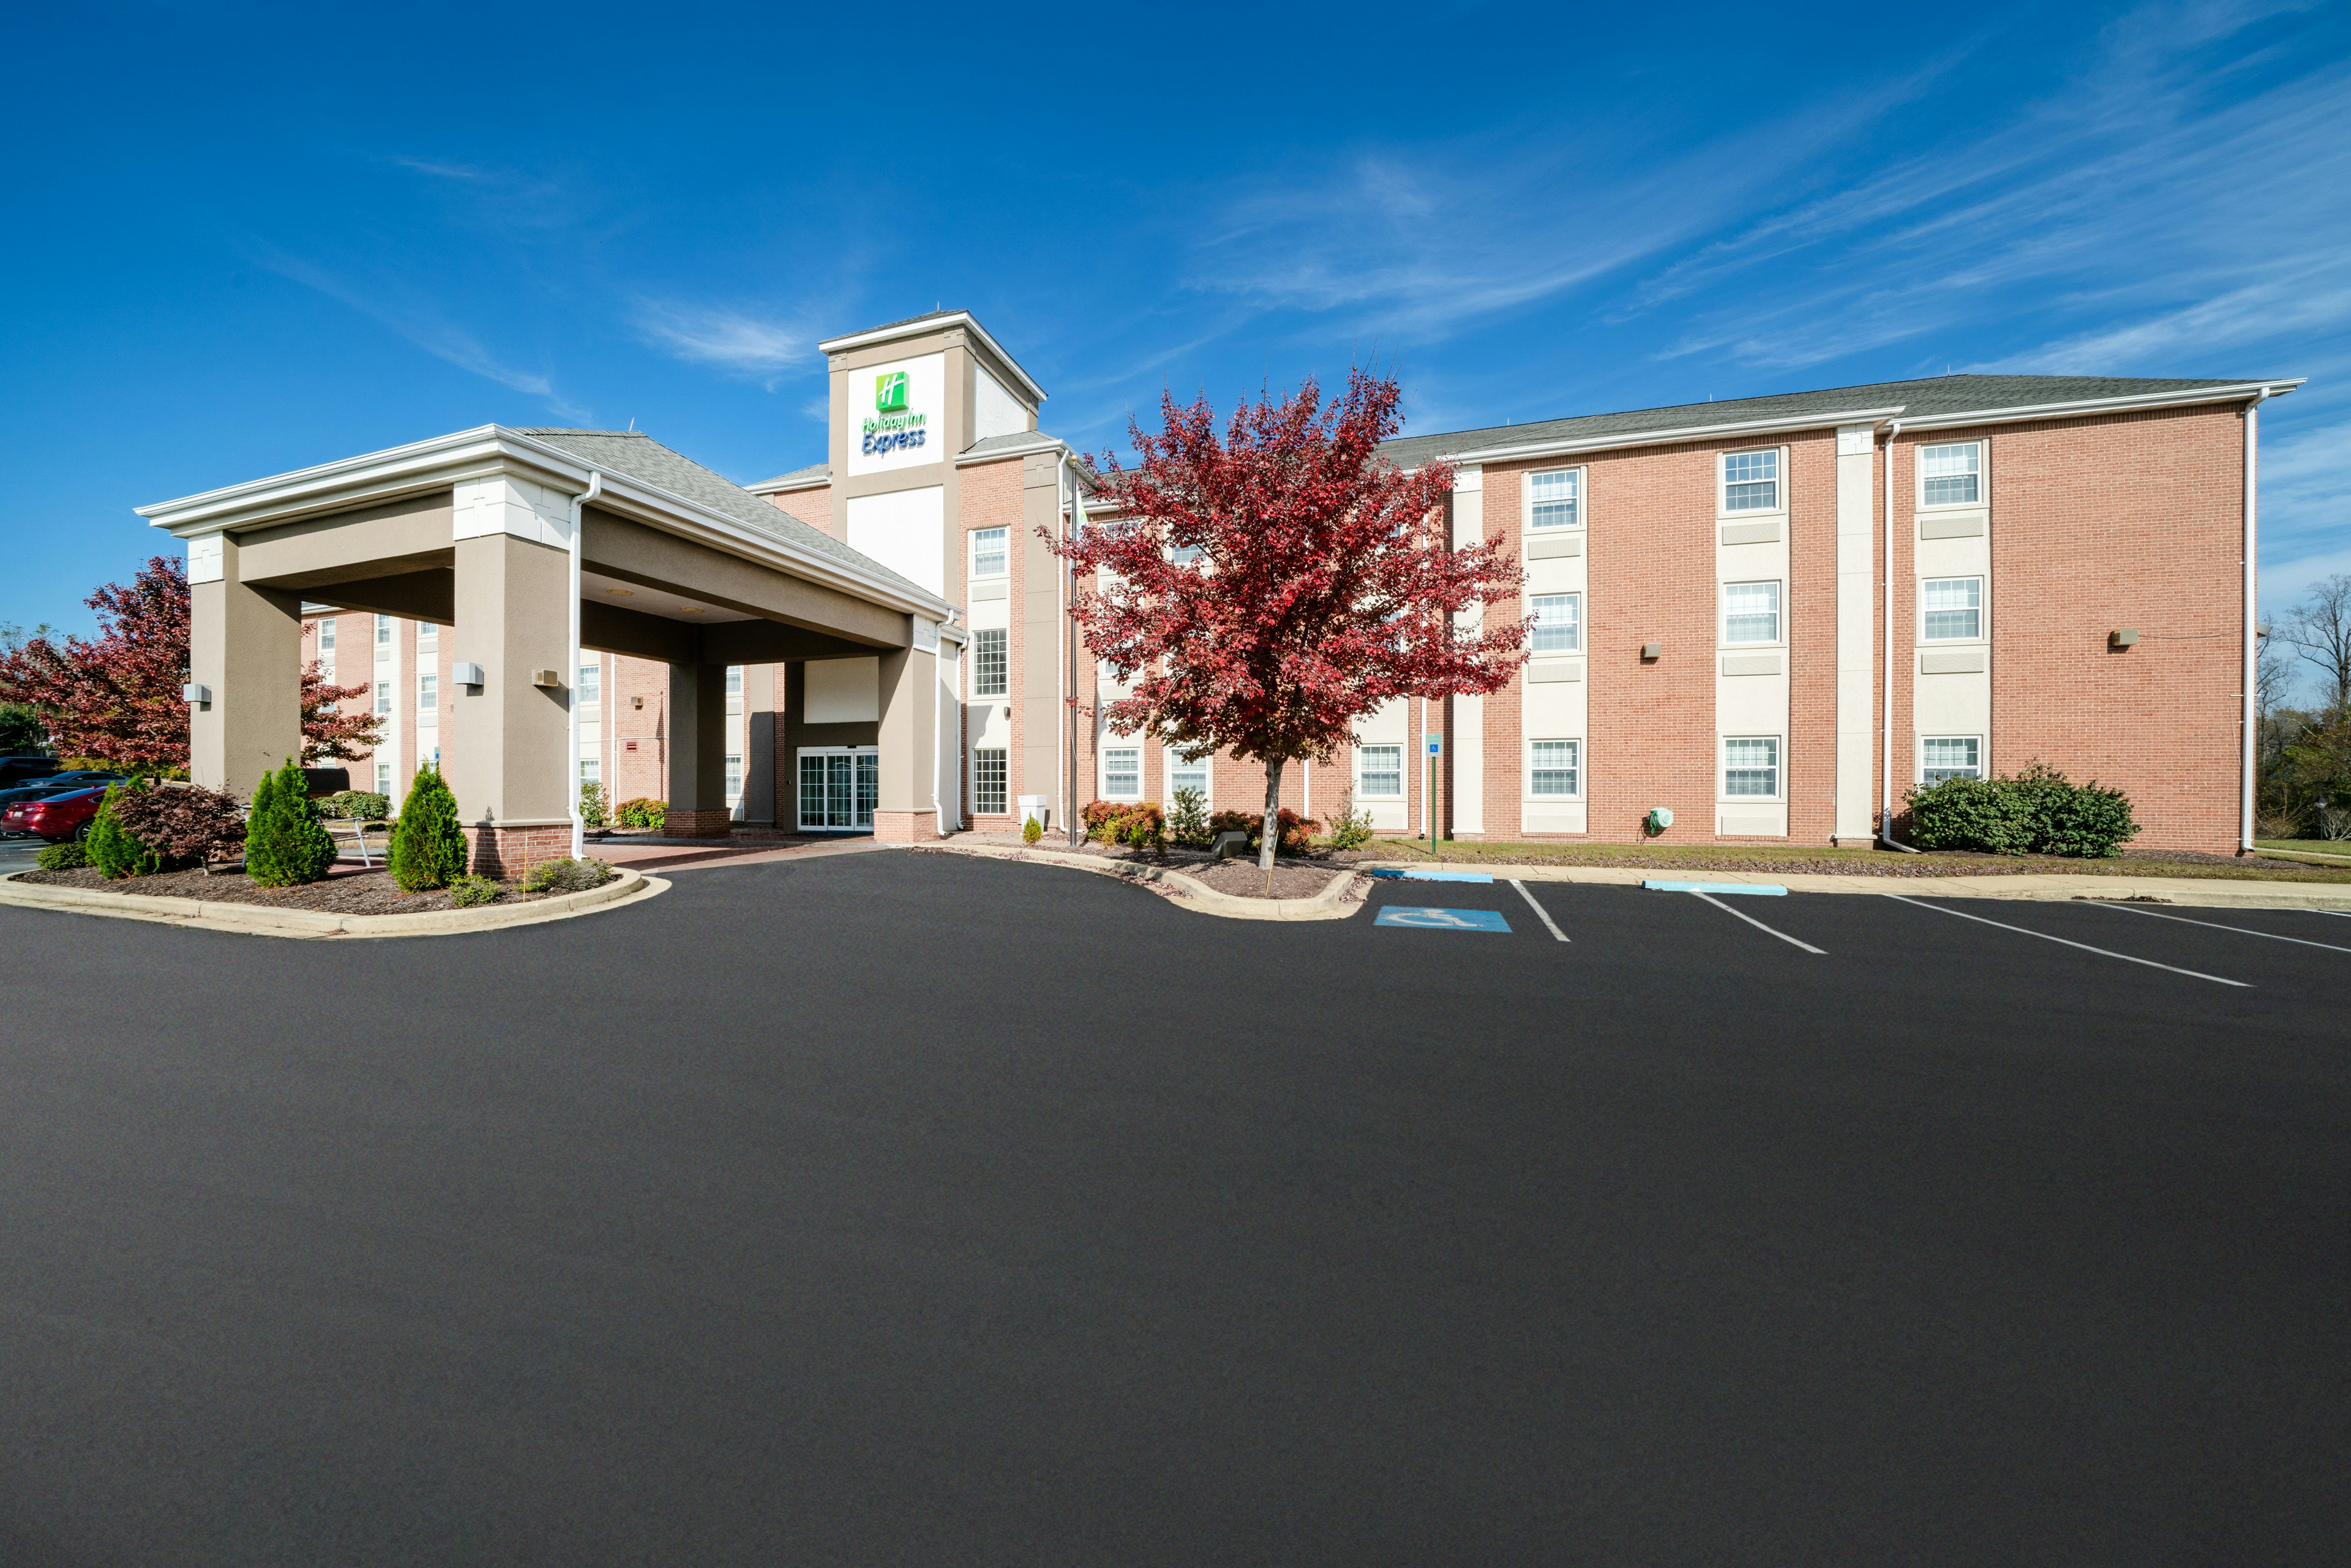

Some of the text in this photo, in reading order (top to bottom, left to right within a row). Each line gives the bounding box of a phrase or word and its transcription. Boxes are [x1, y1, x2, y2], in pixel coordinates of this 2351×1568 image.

[862, 410, 926, 432] Holiday Inn
[861, 429, 926, 454] Express
